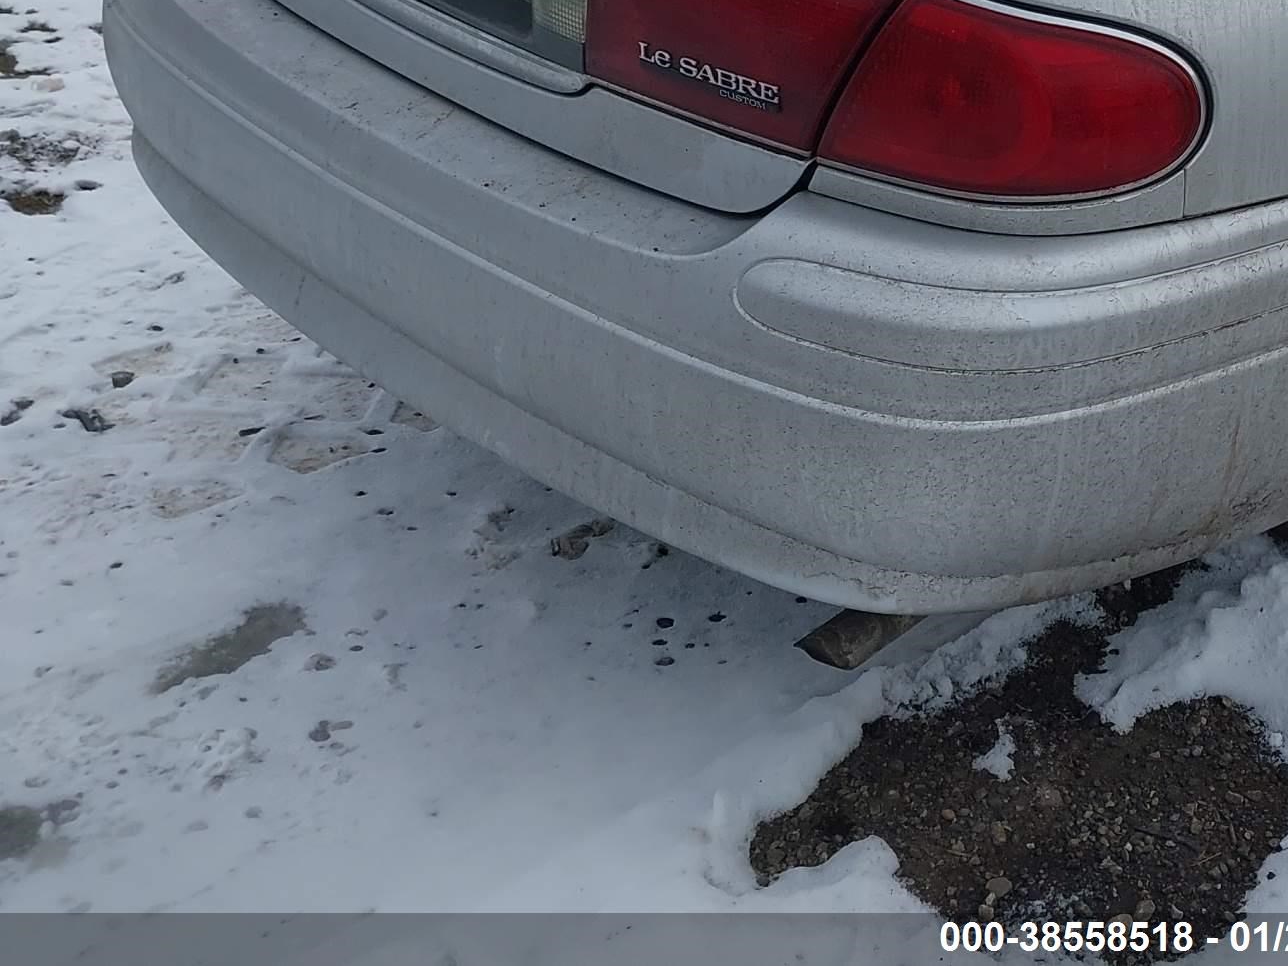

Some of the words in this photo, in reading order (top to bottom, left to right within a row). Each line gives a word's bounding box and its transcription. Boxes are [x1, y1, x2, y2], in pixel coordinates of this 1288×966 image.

[638, 41, 671, 68] Le
[679, 56, 780, 105] SABRE
[719, 89, 768, 111] CUSTOM
